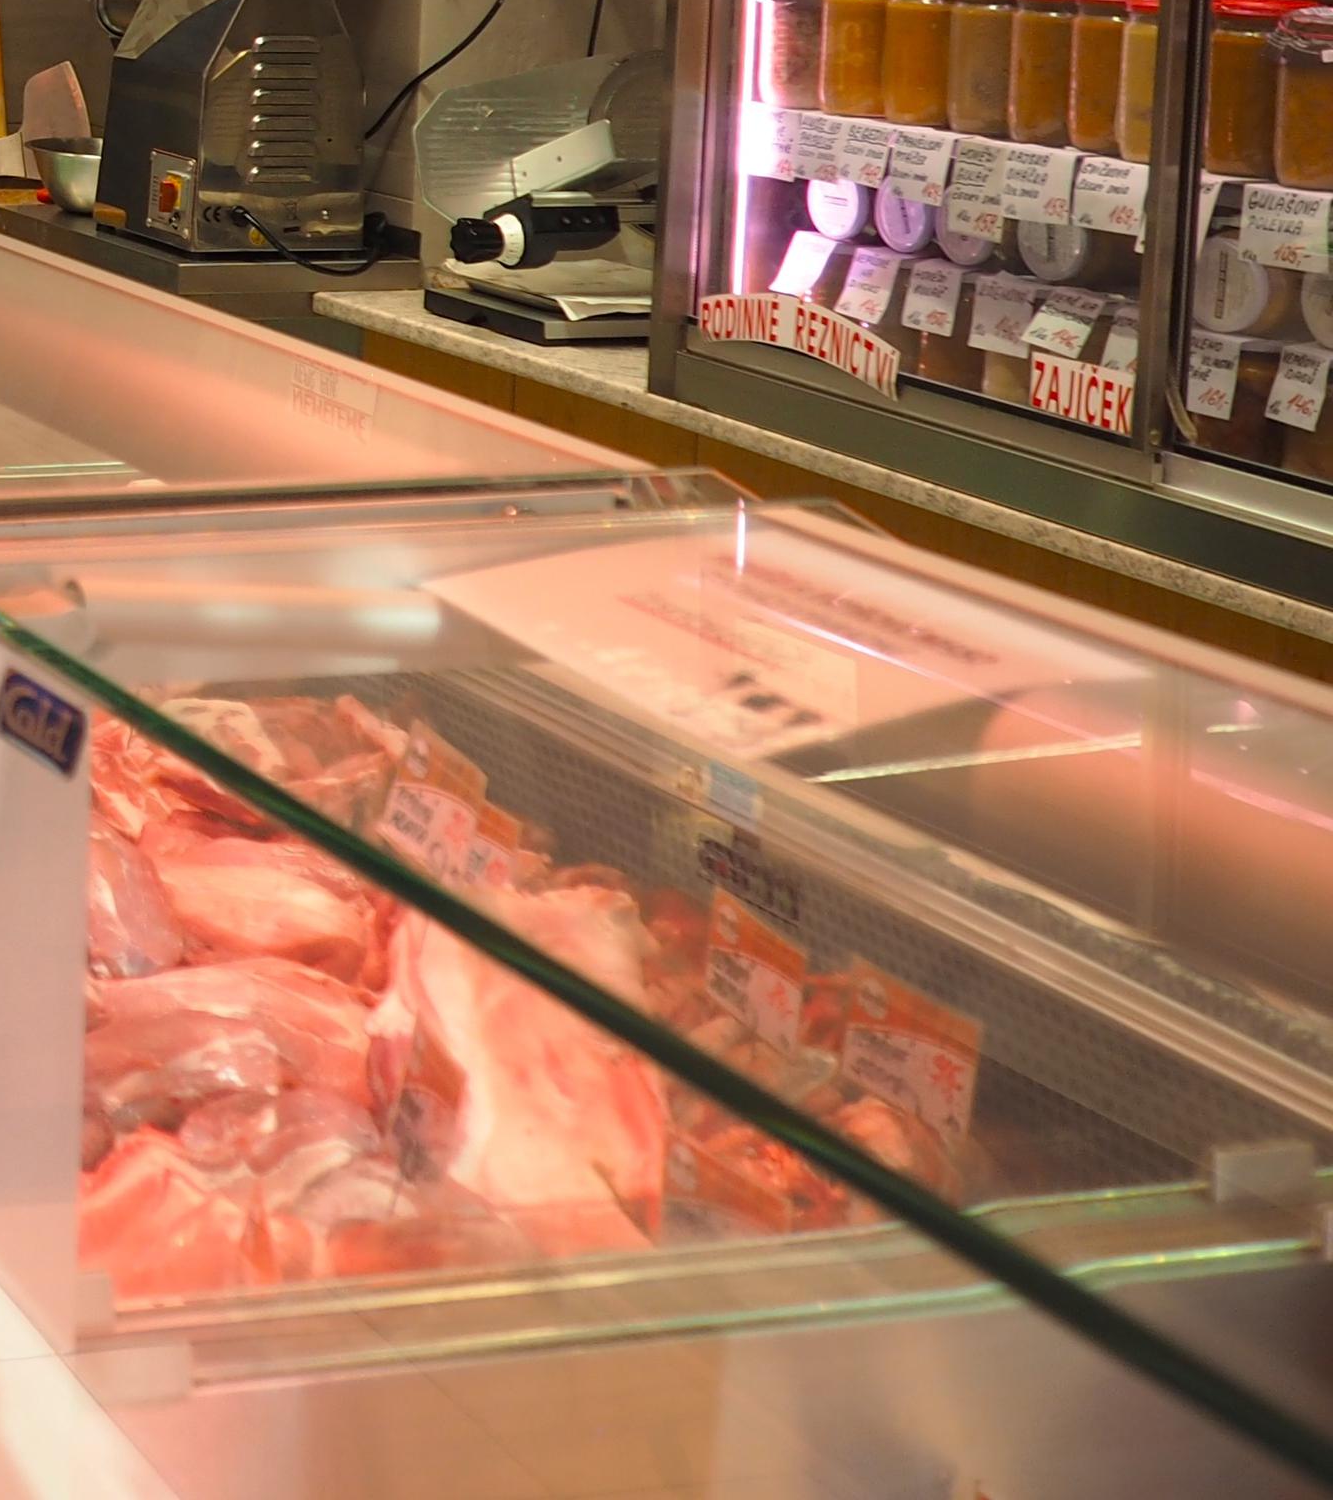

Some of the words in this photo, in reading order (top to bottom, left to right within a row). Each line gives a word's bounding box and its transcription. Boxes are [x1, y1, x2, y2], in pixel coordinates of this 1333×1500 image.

[1247, 190, 1325, 217] GULÁŠOVÁ
[700, 293, 780, 342] RODINNÉ
[796, 298, 900, 392] ŘEZNICTVÍ
[1033, 361, 1133, 436] ZAJÍČEK
